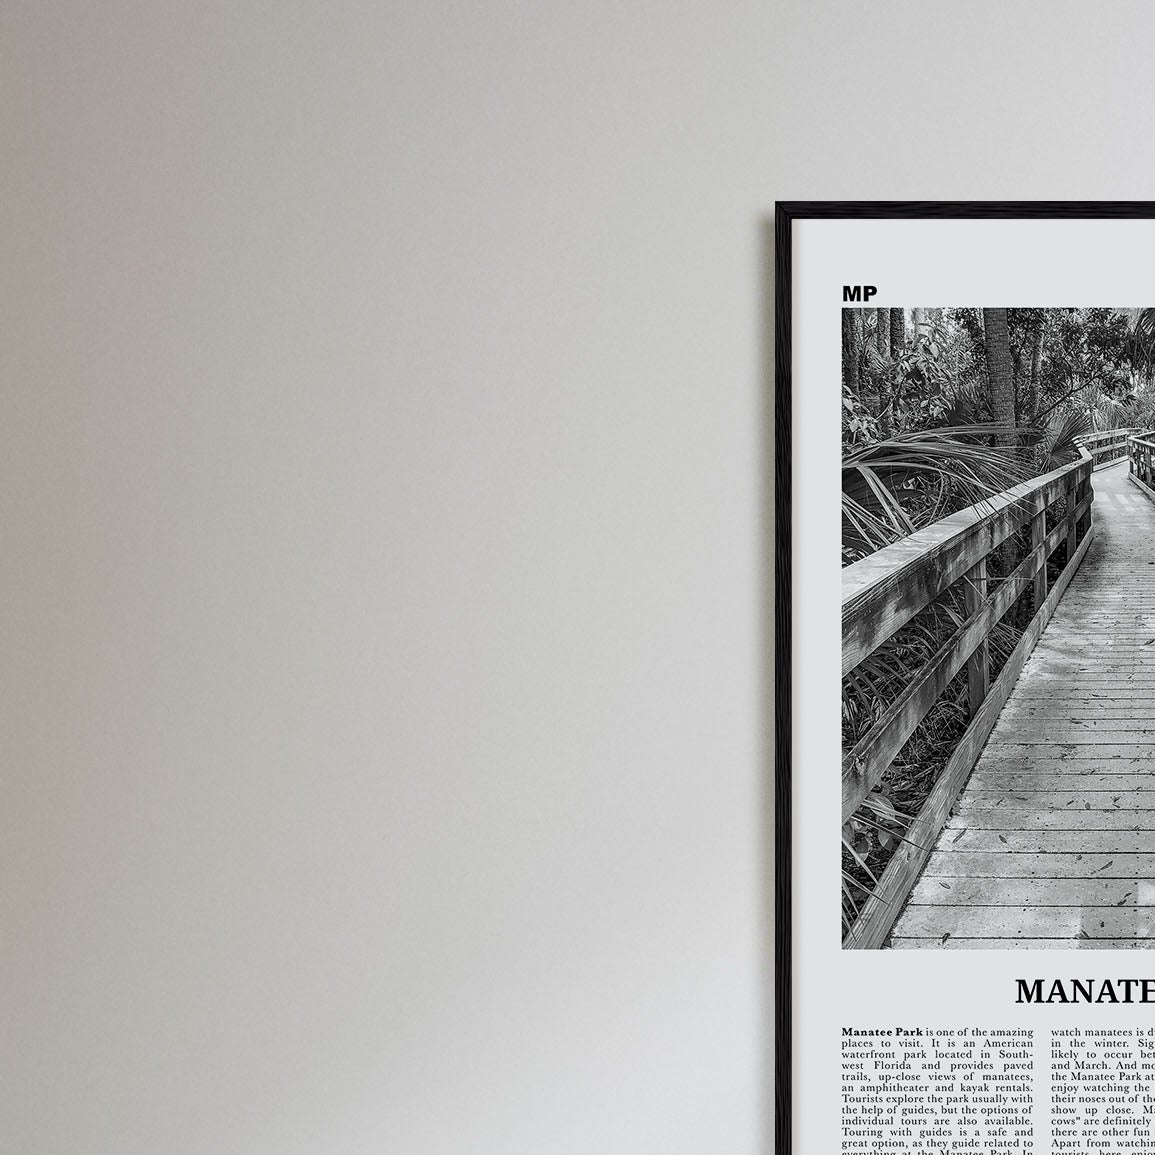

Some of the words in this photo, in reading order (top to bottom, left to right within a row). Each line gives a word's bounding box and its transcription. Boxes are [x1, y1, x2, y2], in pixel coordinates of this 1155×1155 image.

[843, 286, 877, 302] MP
[842, 1027, 893, 1037] Manatee
[895, 1027, 923, 1037] Park
[926, 1028, 934, 1037] is
[957, 1027, 968, 1037] of
[971, 1027, 987, 1037] the
[990, 1028, 1034, 1039] amazing
[1051, 1027, 1081, 1037] watch
[1085, 1028, 1133, 1037] manatees
[1136, 1028, 1144, 1037] is
[841, 1049, 895, 1059] waterfront
[904, 1049, 927, 1061] park
[935, 1049, 972, 1059] located
[980, 1050, 990, 1059] in
[999, 1049, 1033, 1059] South-
[1051, 1049, 1079, 1061] likely
[1086, 1051, 1097, 1059] to
[1051, 1060, 1070, 1070] and
[1074, 1060, 1111, 1070] March.
[1116, 1060, 1137, 1070] And
[842, 1072, 871, 1083] trails,
[878, 1072, 921, 1084] up-close
[928, 1072, 956, 1081] views
[963, 1072, 974, 1081] of
[982, 1073, 1033, 1083] manatees,
[1051, 1072, 1067, 1081] the
[1071, 1072, 1115, 1081] Manatee
[1119, 1072, 1142, 1081] Park
[1145, 1073, 1154, 1081] at
[842, 1094, 883, 1103] Tourists
[886, 1094, 924, 1106] explore
[927, 1094, 943, 1103] the
[946, 1094, 969, 1106] park
[972, 1094, 1008, 1106] usually
[1011, 1094, 1033, 1103] with
[1051, 1094, 1076, 1103] their
[1108, 1095, 1125, 1103] out
[1128, 1094, 1139, 1103] of
[842, 1105, 858, 1114] the
[861, 1105, 884, 1117] help
[886, 1105, 897, 1114] of
[901, 1105, 938, 1117] guides,
[941, 1105, 958, 1114] but
[961, 1105, 977, 1114] the
[980, 1105, 1019, 1117] options
[1021, 1105, 1032, 1114] of
[1051, 1105, 1077, 1114] show
[1085, 1108, 1098, 1117] up
[1106, 1105, 1134, 1114] close.
[1051, 1127, 1078, 1136] there
[1102, 1127, 1129, 1136] other
[1133, 1127, 1150, 1136] fun
[841, 1139, 868, 1150] great
[871, 1139, 908, 1150] option,
[926, 1138, 948, 1150] they
[952, 1138, 980, 1150] guide
[984, 1138, 1020, 1148] related
[1023, 1139, 1034, 1148] to
